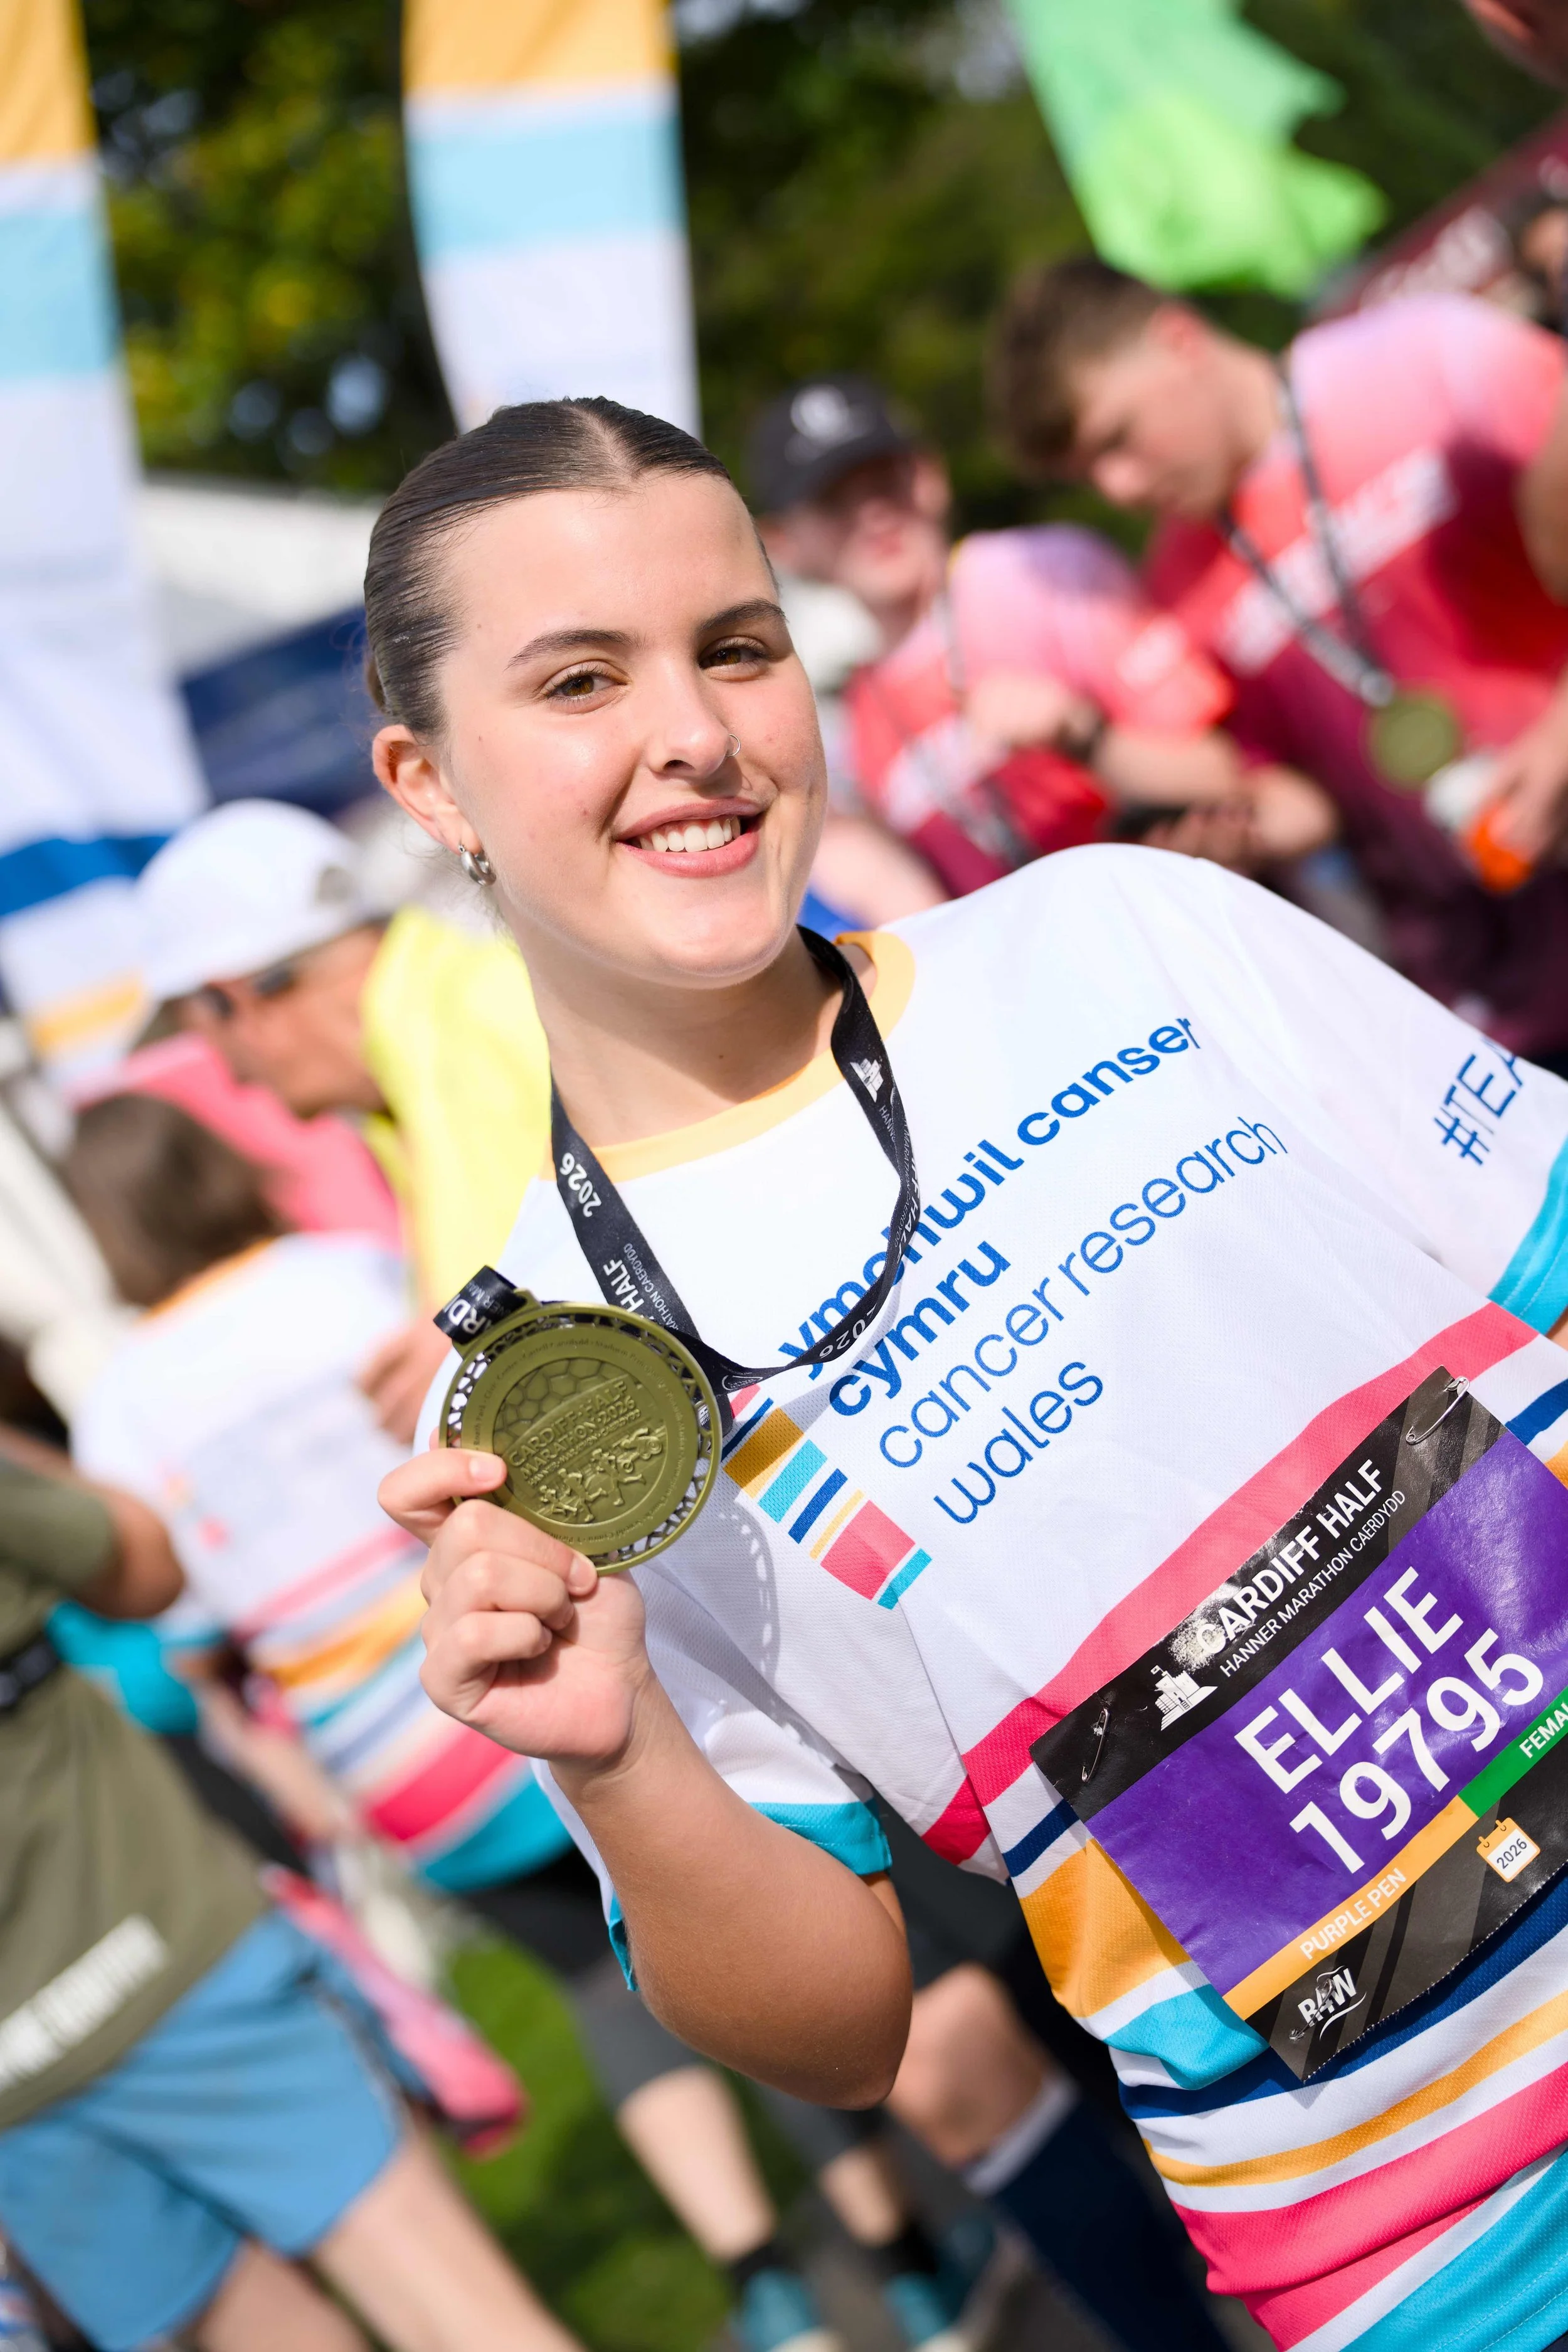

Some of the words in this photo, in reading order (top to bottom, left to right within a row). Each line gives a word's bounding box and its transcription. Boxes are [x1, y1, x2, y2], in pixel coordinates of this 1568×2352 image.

[1017, 1017, 1200, 1145] canser
[559, 1152, 602, 1217] 2026
[602, 1258, 645, 1314] HALF
[829, 1239, 1012, 1416] cymru
[879, 1278, 1064, 1468] cancer
[1058, 1116, 1288, 1296] research
[933, 1360, 1103, 1524] wales
[1196, 1525, 1319, 1654] CARDIFF
[1316, 1459, 1382, 1539] HALF
[1219, 1618, 1282, 1677] HANNER
[1277, 1547, 1353, 1623] MARATHON
[1350, 1490, 1406, 1552] CAERDYDD
[1234, 1566, 1463, 1794] ELLIE
[1290, 1629, 1544, 1875] 19795
[1300, 1900, 1372, 1960] PURPLE
[1367, 1868, 1407, 1908] PEN
[1496, 1838, 1528, 1870] 2026
